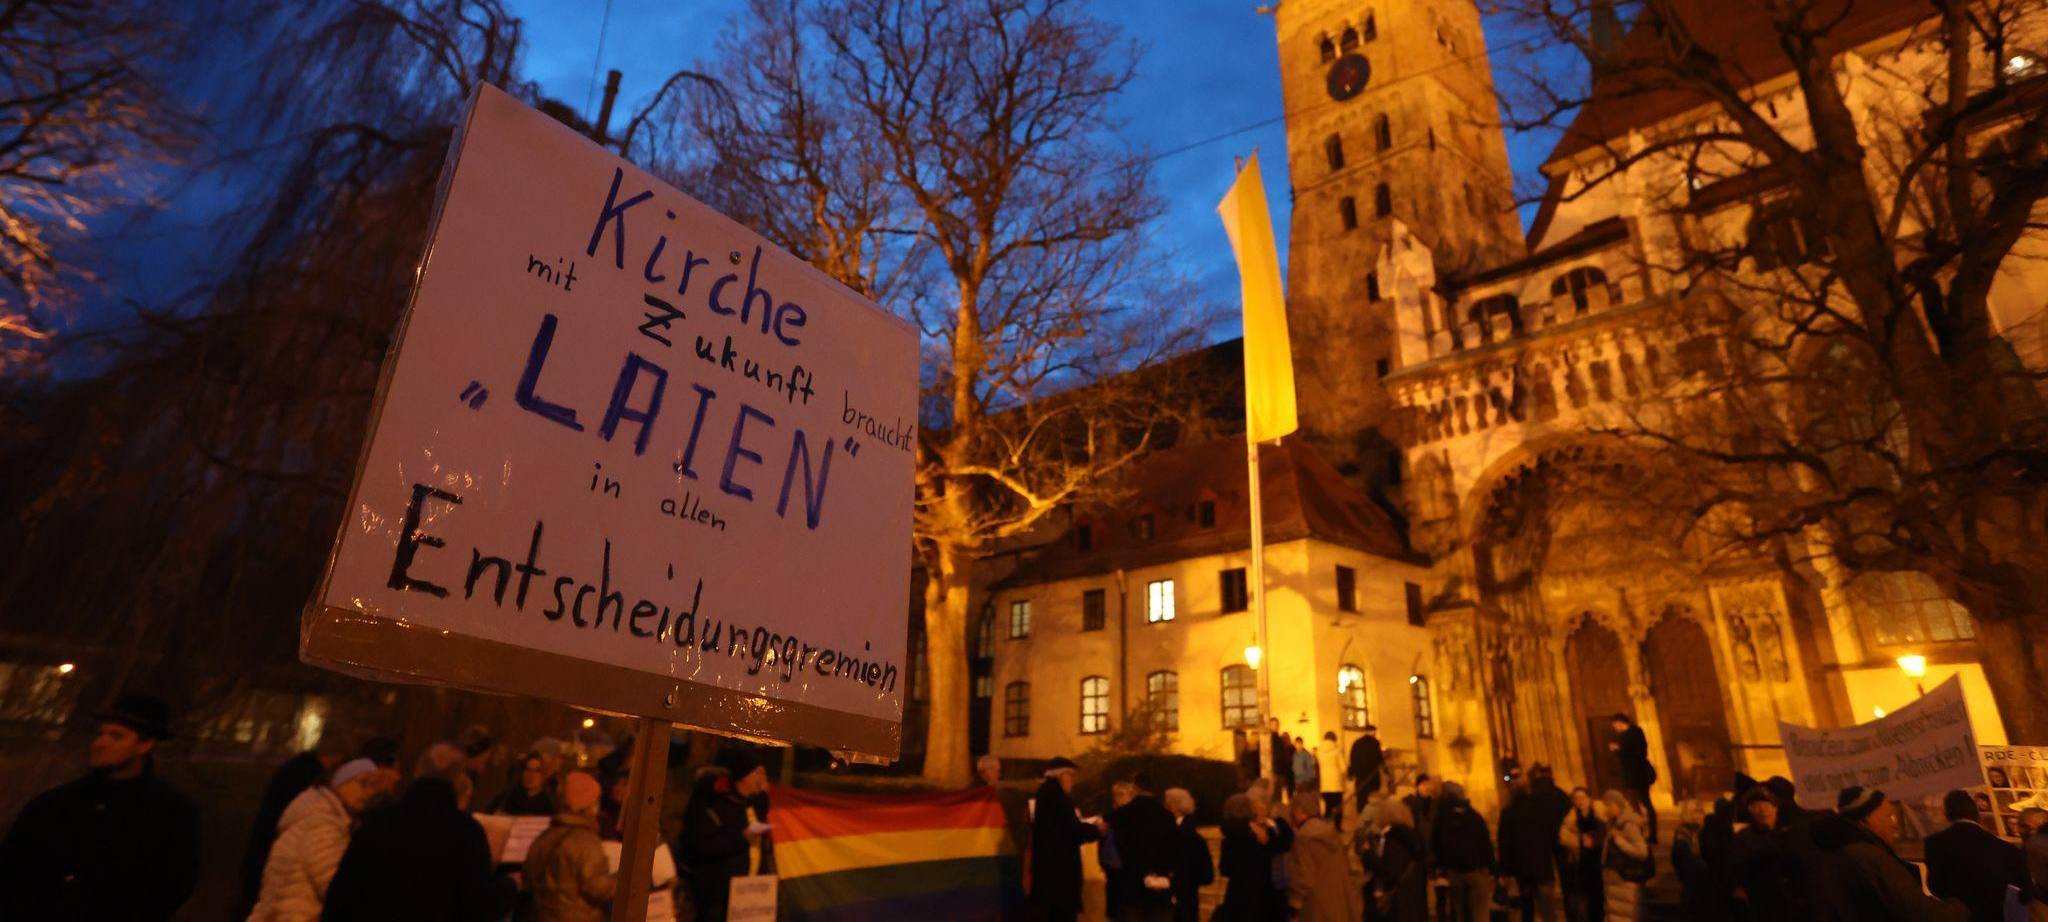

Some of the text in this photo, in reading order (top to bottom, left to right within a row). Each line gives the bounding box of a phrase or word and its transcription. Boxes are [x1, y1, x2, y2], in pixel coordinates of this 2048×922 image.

[586, 166, 809, 347] Kirche
[527, 252, 914, 454] mit Zukunft braucht
[386, 482, 899, 693] Entscheidungsgremien
[590, 462, 726, 532] in allen
